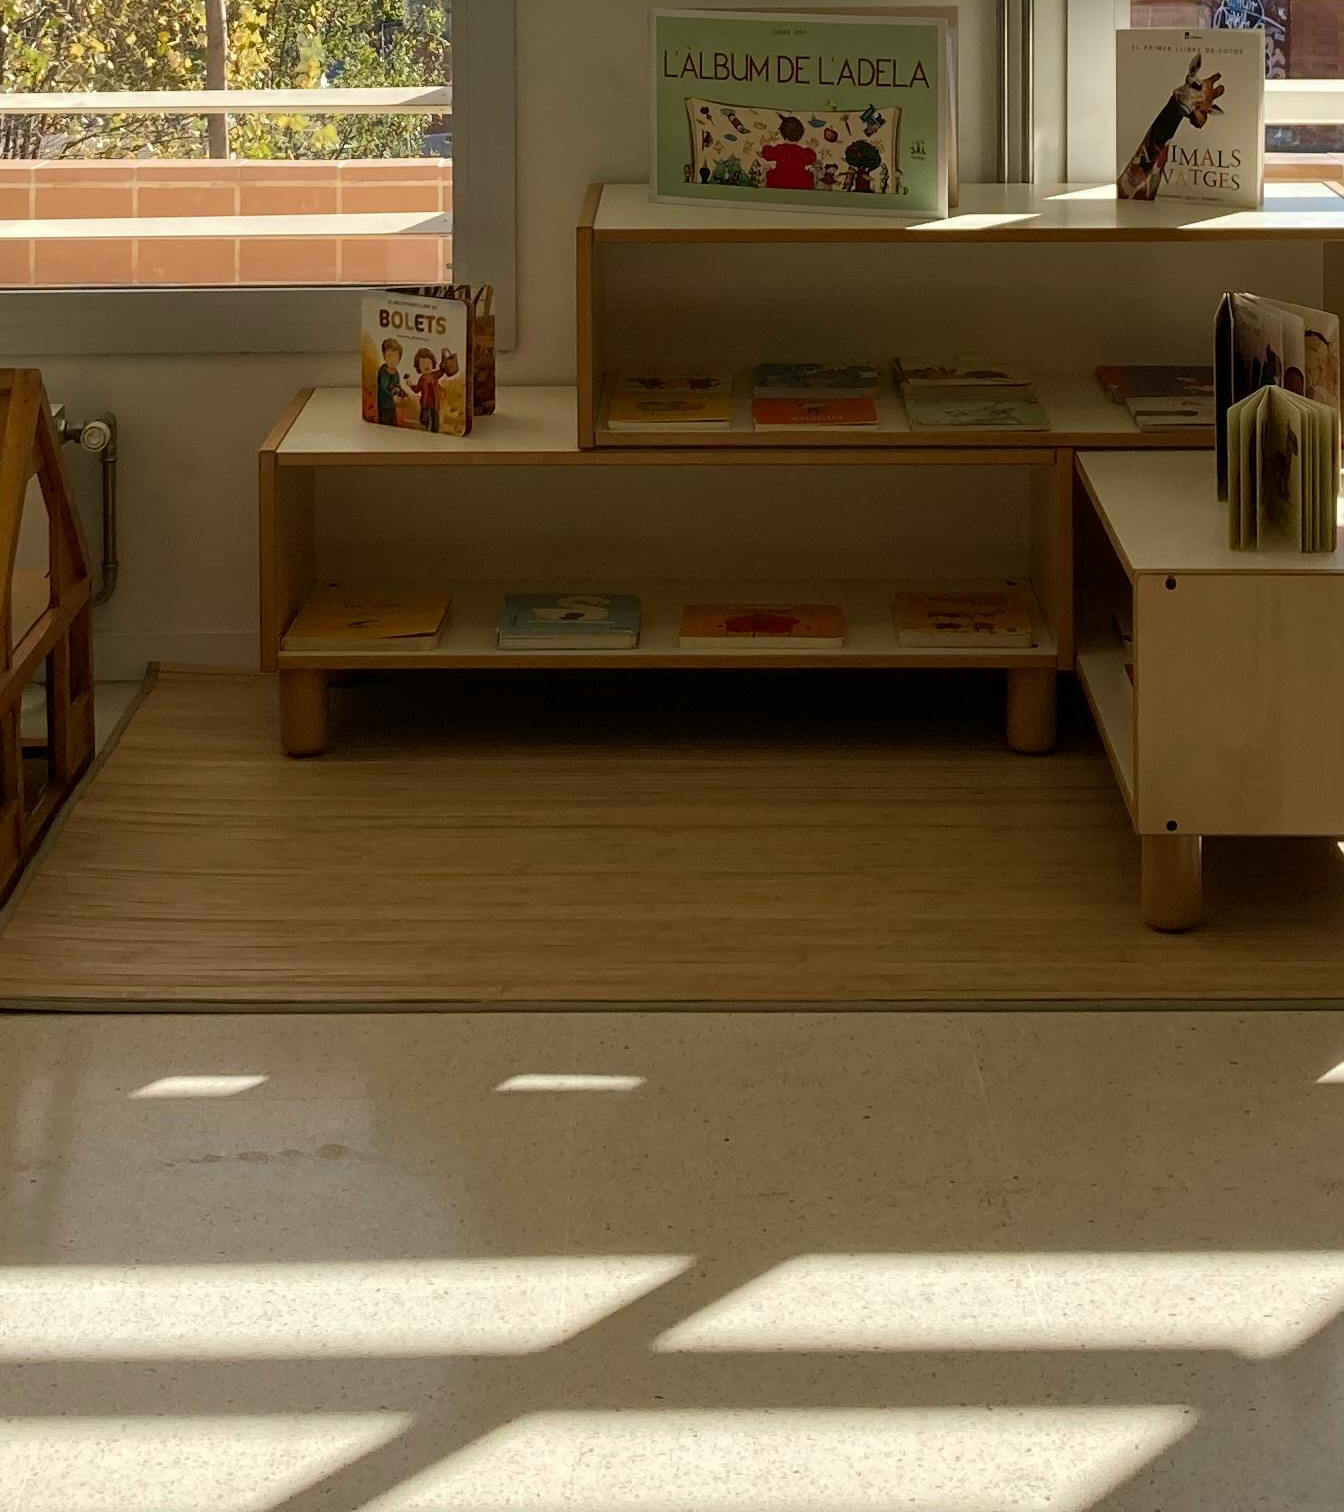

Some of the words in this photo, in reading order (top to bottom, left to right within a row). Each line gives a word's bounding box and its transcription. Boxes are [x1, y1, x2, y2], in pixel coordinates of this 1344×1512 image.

[776, 55, 811, 85] DE
[818, 56, 930, 89] L'ADELA
[379, 309, 447, 335] BOLETS
